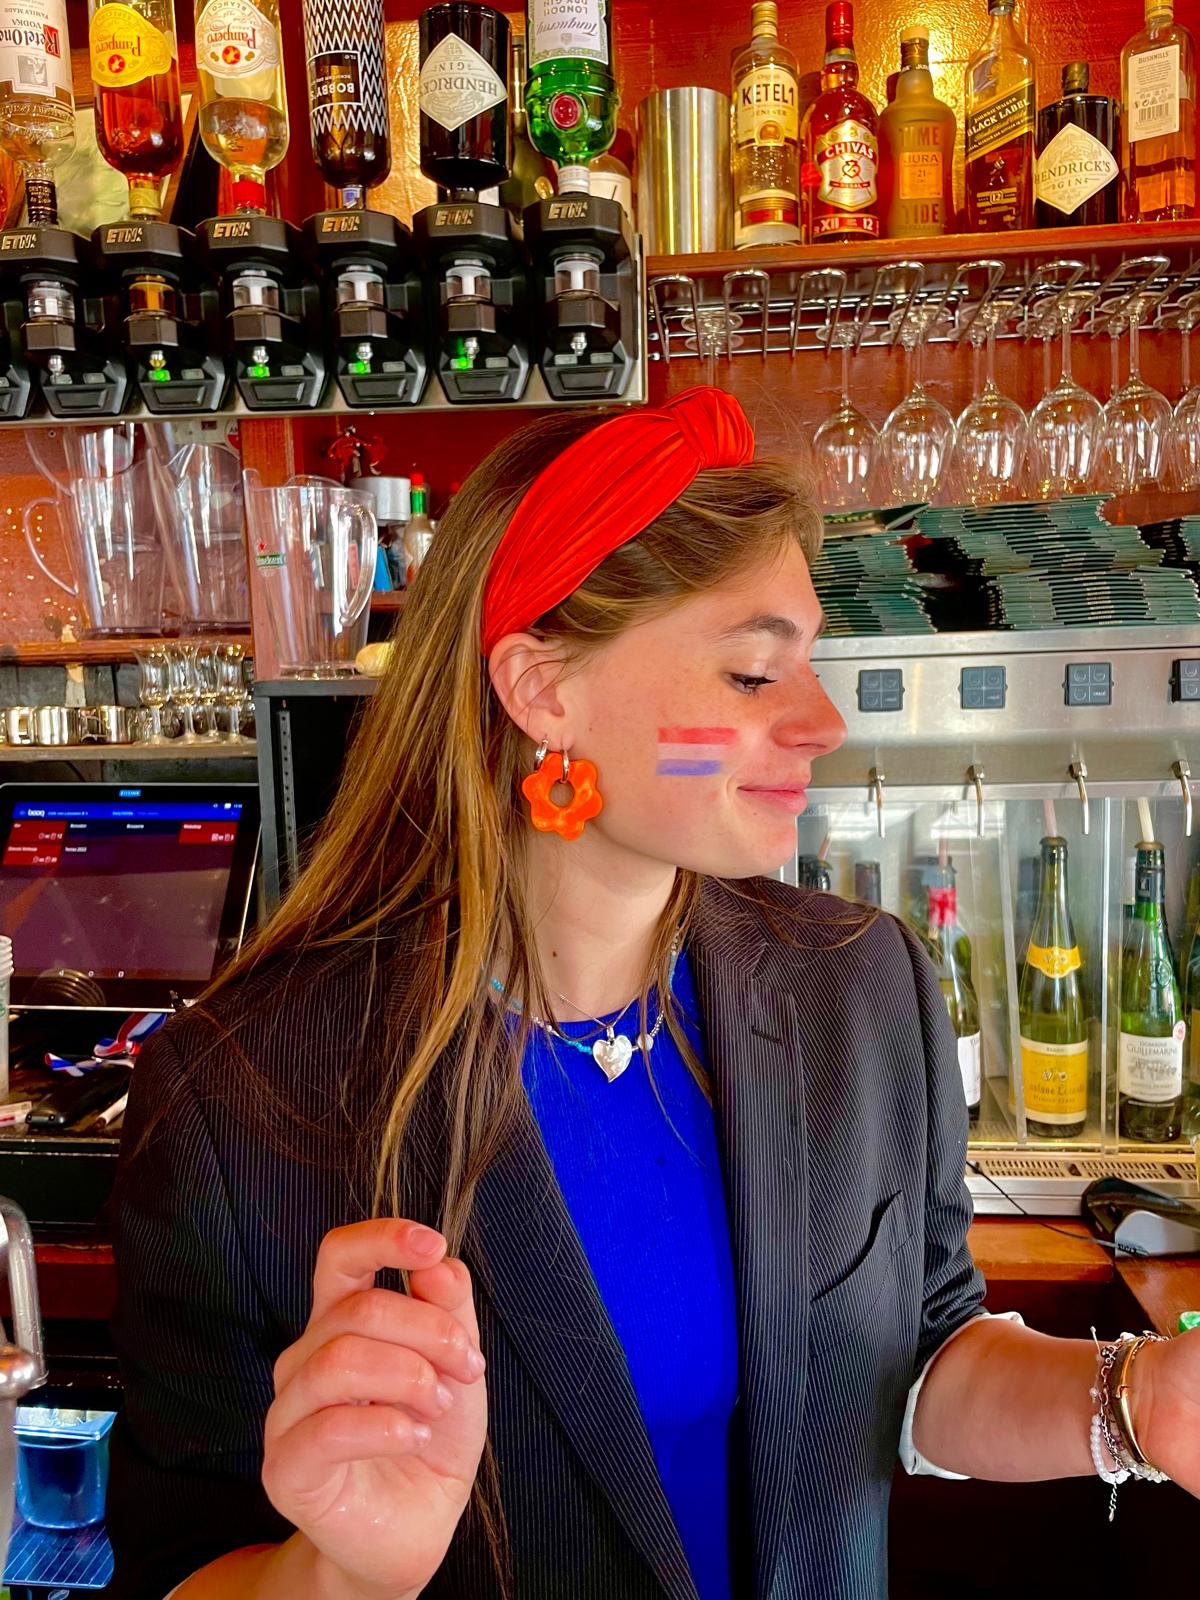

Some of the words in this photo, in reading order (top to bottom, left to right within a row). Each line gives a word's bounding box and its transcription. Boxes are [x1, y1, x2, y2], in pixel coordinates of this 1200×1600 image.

[543, 5, 588, 17] LONDON
[11, 18, 42, 30] VODKA
[206, 23, 258, 50] Pampero
[94, 33, 142, 58] Pampero
[1137, 50, 1169, 65] BUSHMILLS
[438, 61, 465, 72] GIN
[998, 98, 1030, 119] LABEL
[824, 142, 874, 159] CHIVAS
[903, 153, 939, 164] JURA
[1034, 160, 1112, 185] HENDRICK'S
[901, 203, 940, 225] TIDE
[820, 217, 840, 232] XII
[862, 218, 874, 231] 12
[27, 808, 46, 818] booq
